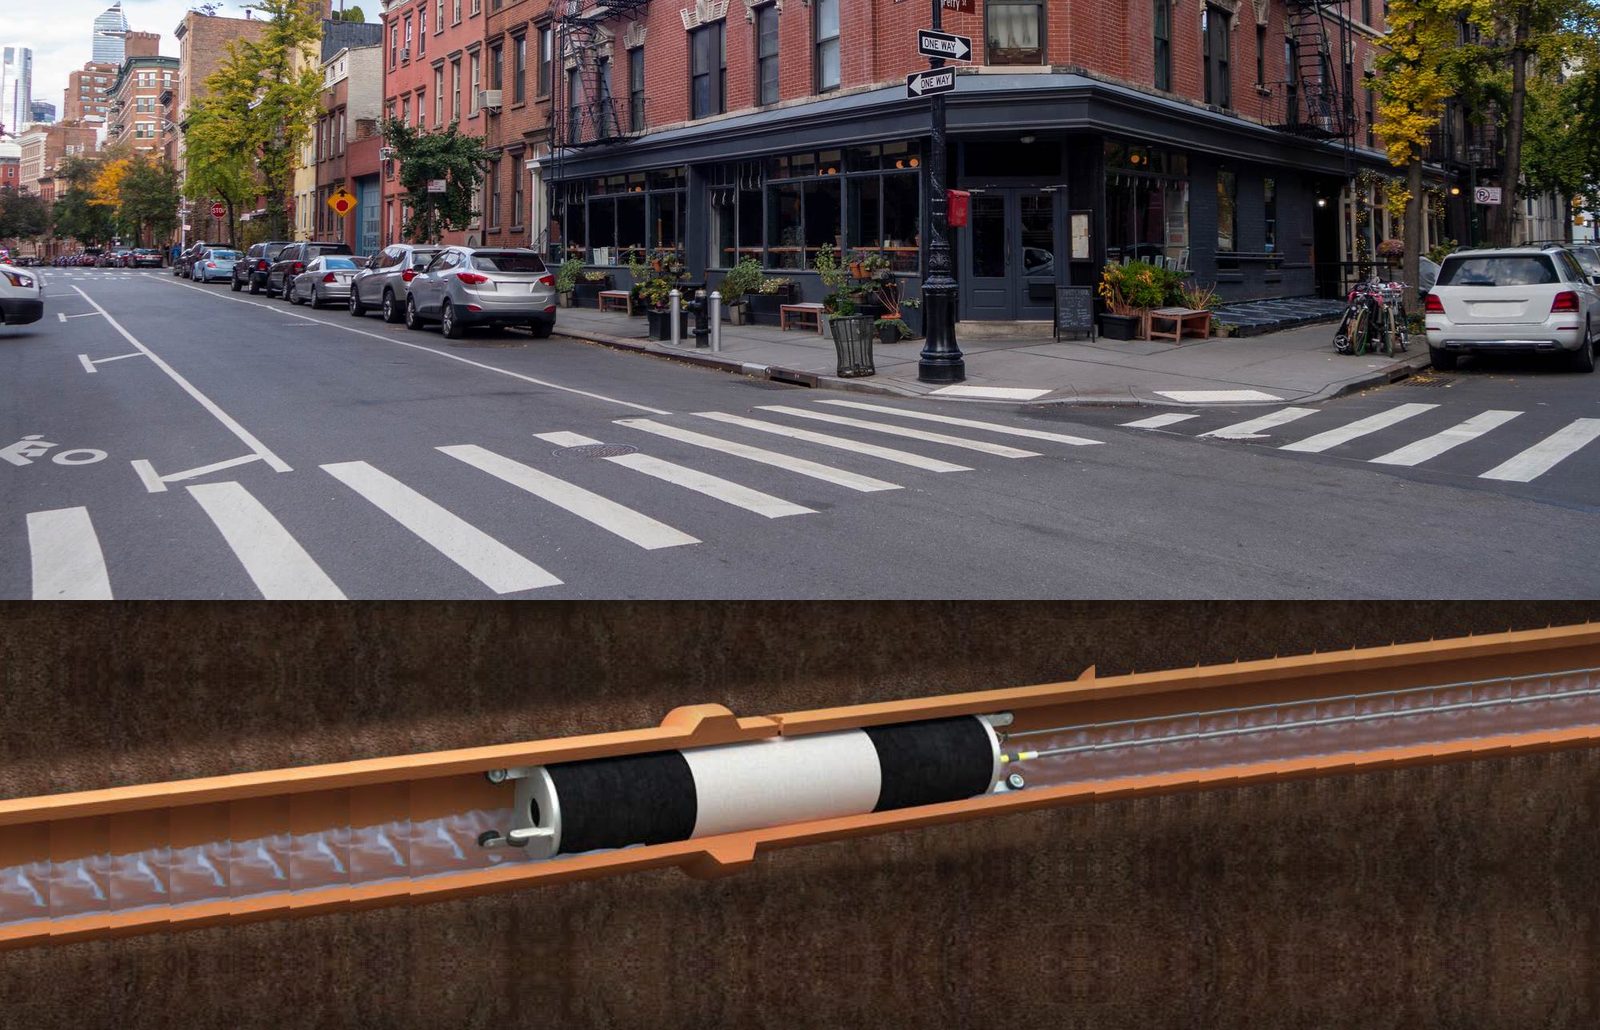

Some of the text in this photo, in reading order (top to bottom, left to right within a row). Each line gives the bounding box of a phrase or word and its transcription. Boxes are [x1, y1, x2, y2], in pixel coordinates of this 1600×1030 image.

[943, 0, 960, 11] erry
[924, 38, 956, 52] ONE WAY
[920, 74, 950, 89] ONE WAY
